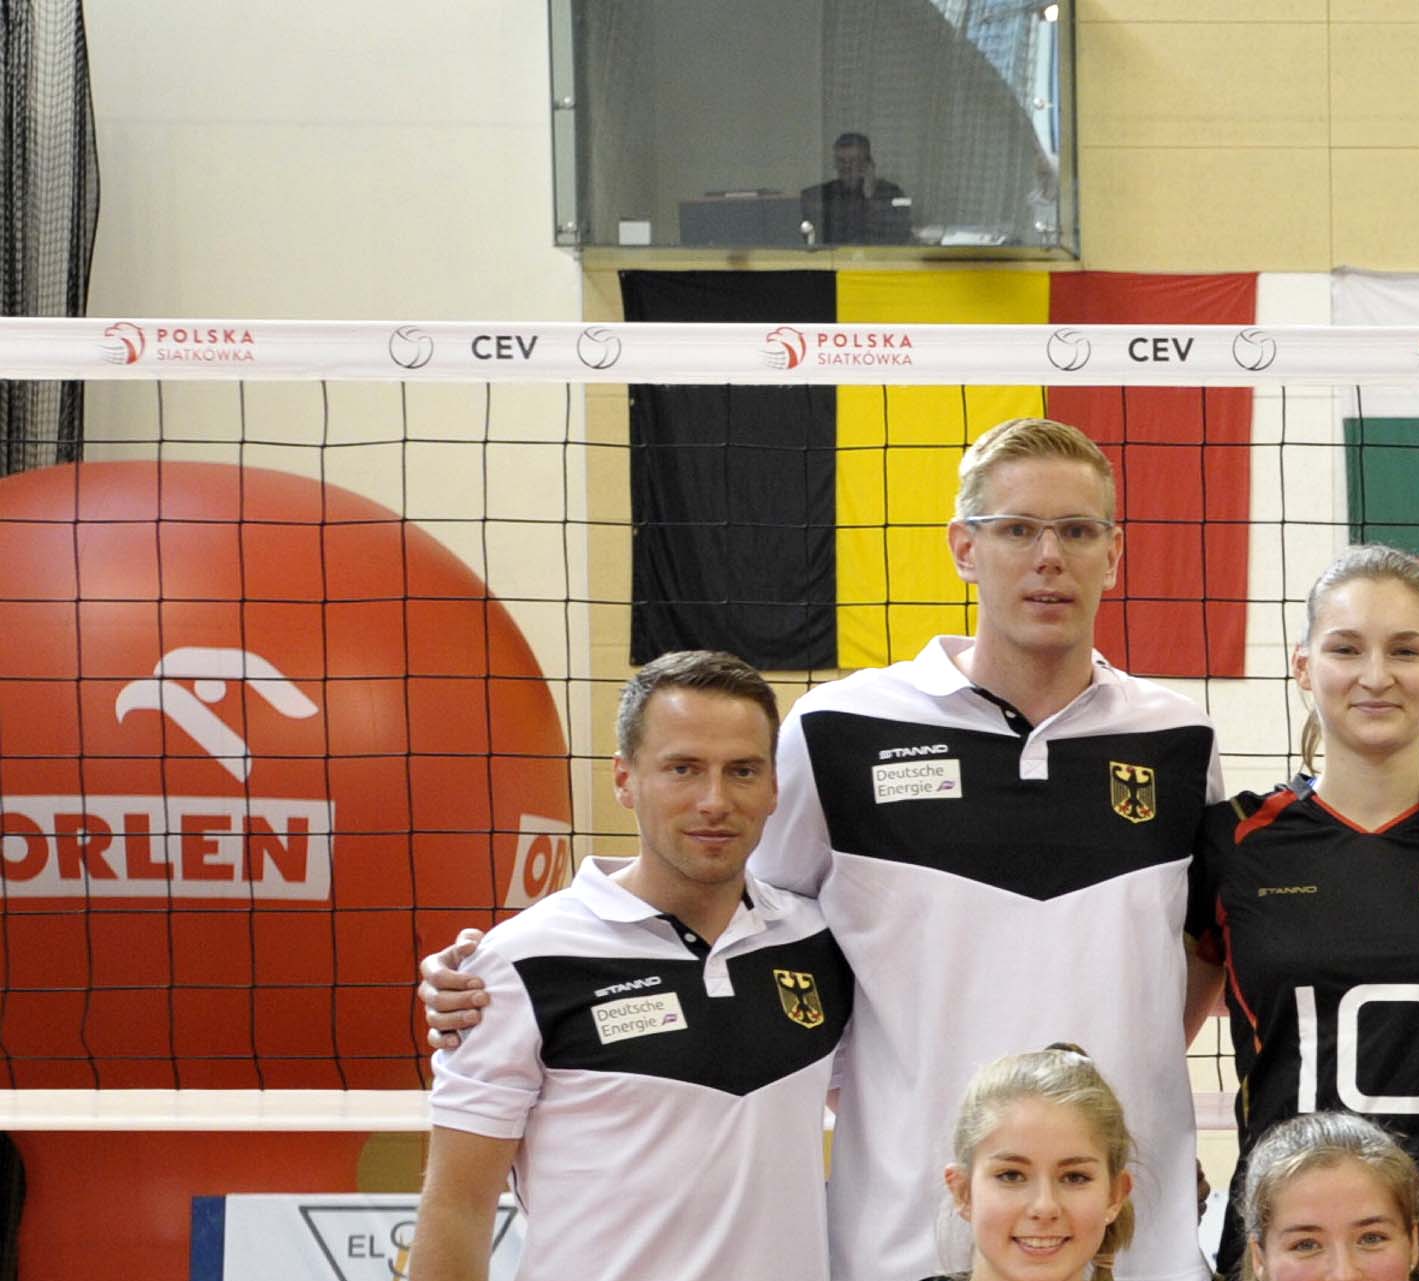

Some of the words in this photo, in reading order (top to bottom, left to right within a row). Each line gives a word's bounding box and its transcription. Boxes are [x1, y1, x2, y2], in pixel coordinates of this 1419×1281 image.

[157, 328, 255, 345] POLSKA
[817, 332, 913, 349] POLSKA
[157, 345, 255, 362] SIATKÓWKA
[471, 335, 538, 360] CEV
[817, 348, 913, 366] SIATKÓWKA
[1128, 338, 1194, 363] CEV
[879, 744, 949, 760] STANNO
[877, 764, 945, 782] Deutsche
[880, 779, 934, 799] Energie
[0, 812, 309, 883] ORLEN
[1258, 885, 1318, 898] STANNO
[594, 976, 662, 998] STANNO
[597, 1000, 665, 1022] Deutsche
[601, 1014, 658, 1038] Energie
